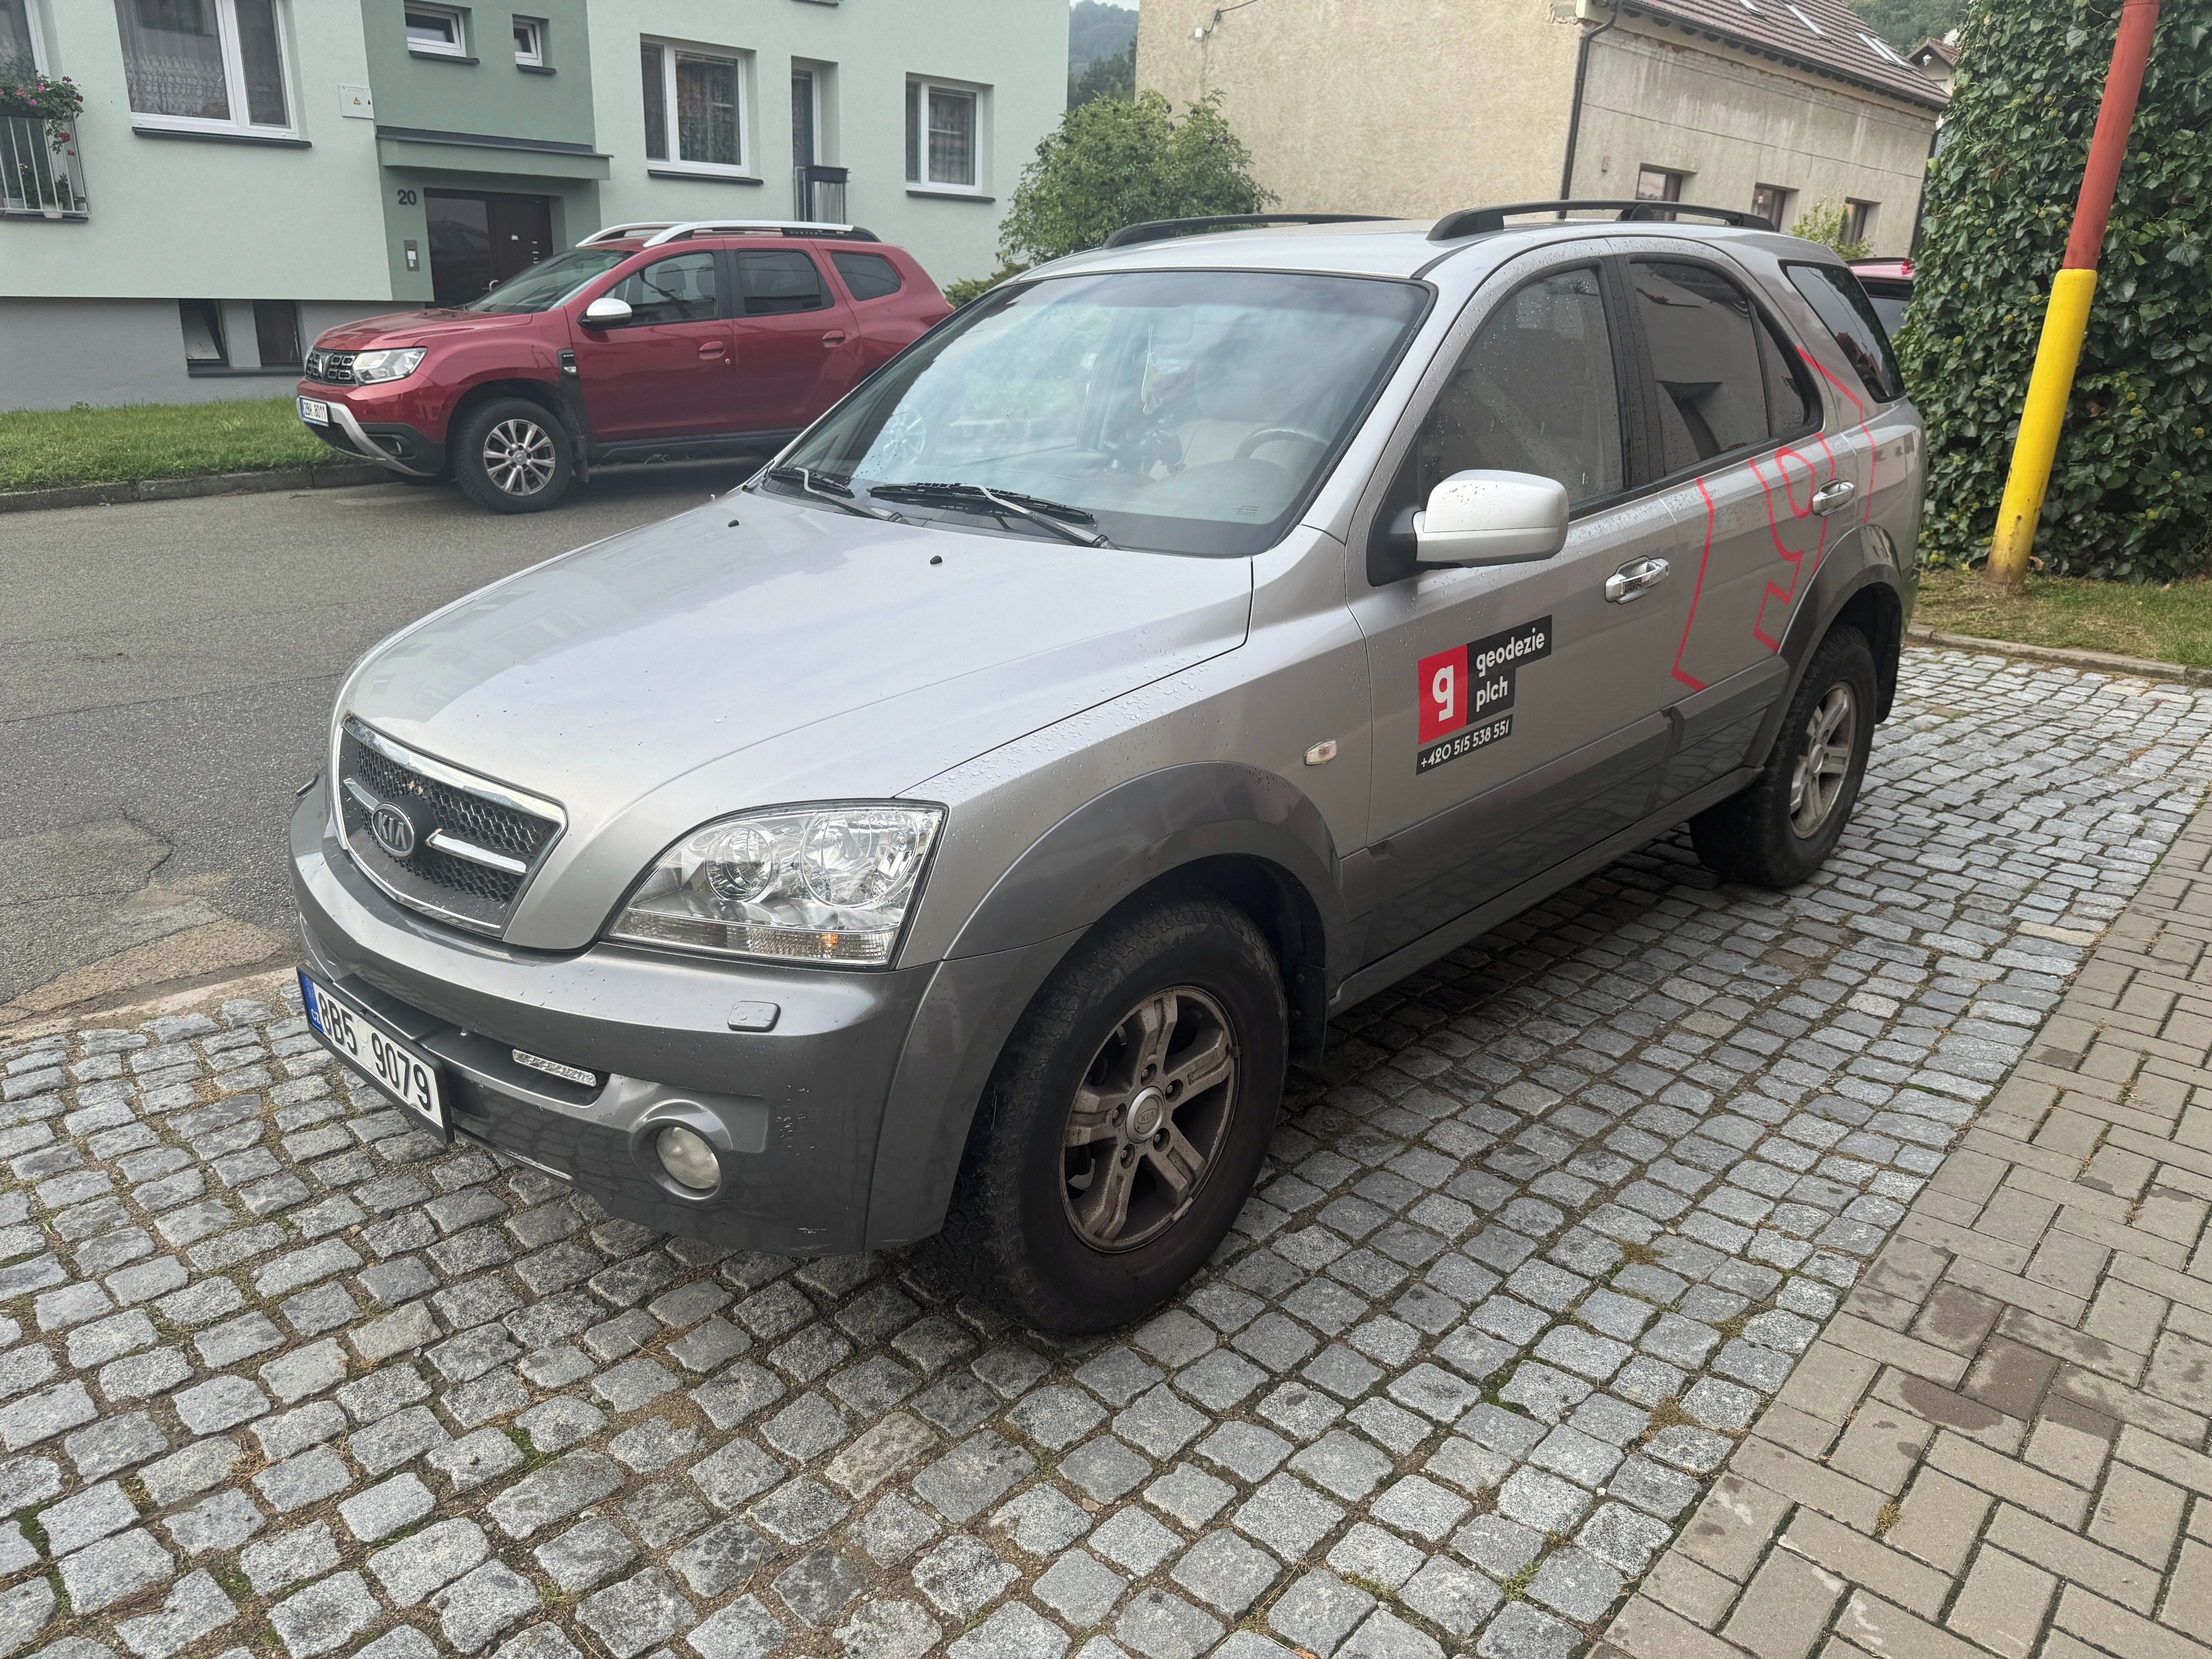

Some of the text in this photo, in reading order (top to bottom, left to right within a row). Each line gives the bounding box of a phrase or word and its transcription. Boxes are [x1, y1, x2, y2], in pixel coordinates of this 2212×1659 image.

[397, 189, 416, 205] 20
[1476, 627, 1545, 678] geodezie
[1476, 676, 1508, 712] plch
[1421, 719, 1509, 768] +420 515 538 551
[378, 811, 408, 850] KIA
[311, 1009, 321, 1025] CZ
[318, 992, 432, 1112] 8B5 9079
[1141, 1110, 1155, 1122] KIA
